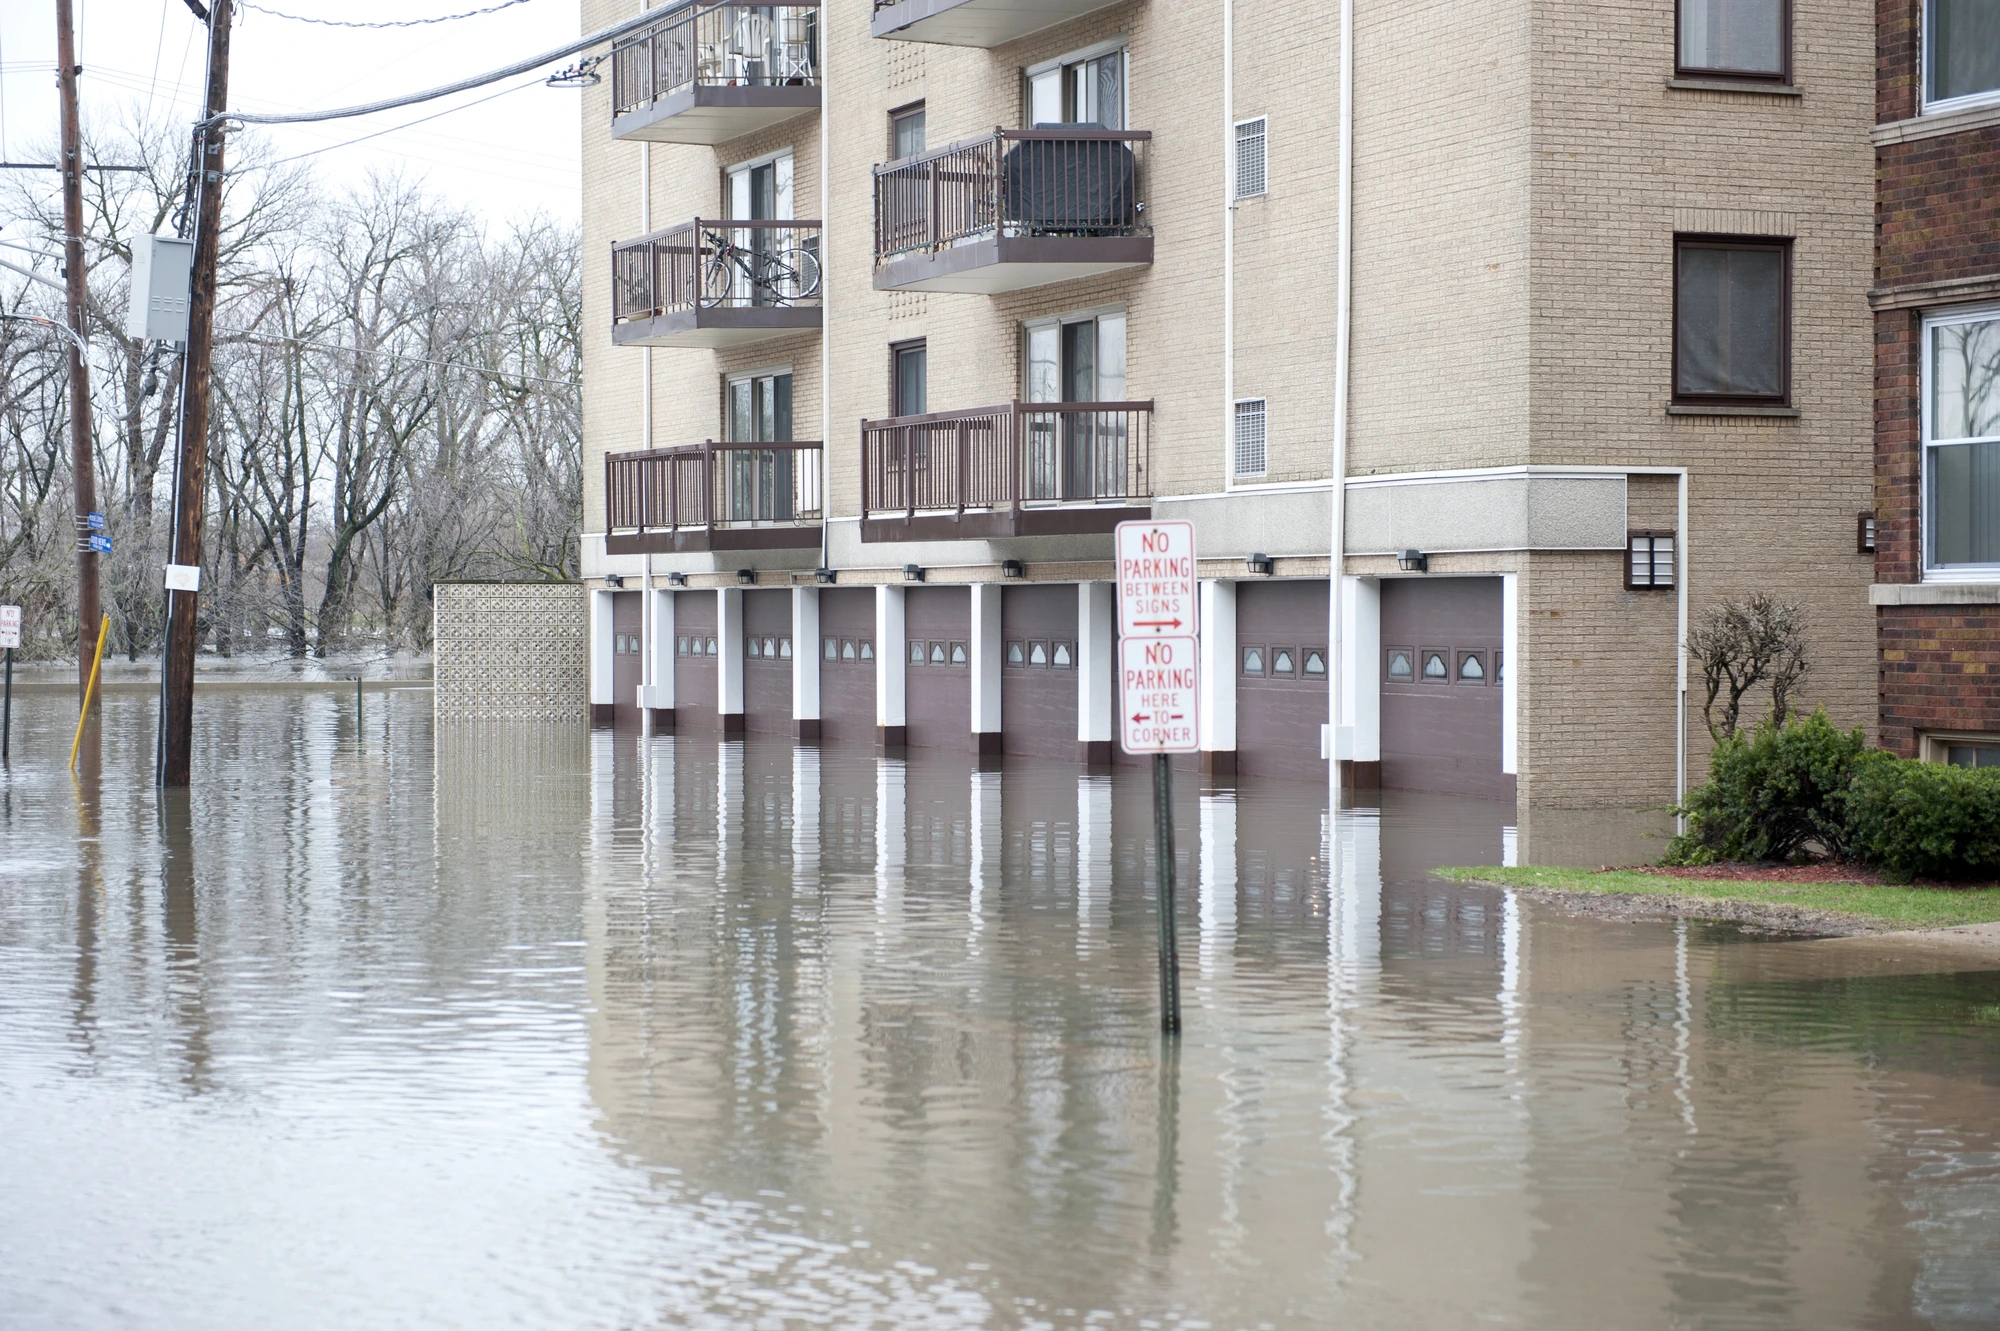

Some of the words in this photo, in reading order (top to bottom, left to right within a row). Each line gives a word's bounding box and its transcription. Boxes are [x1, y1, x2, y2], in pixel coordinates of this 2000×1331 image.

[1142, 532, 1169, 553] NO
[1124, 557, 1189, 579] PARKING
[1126, 581, 1189, 597] BETWEEN
[6, 610, 15, 618] NO
[1136, 599, 1180, 614] SIGNS
[0, 620, 18, 628] PARKING
[1146, 644, 1172, 665] NO
[1127, 668, 1193, 690] PARKING
[1142, 693, 1179, 708] HERE
[1153, 710, 1169, 725] TO
[1133, 727, 1191, 743] CORNER
